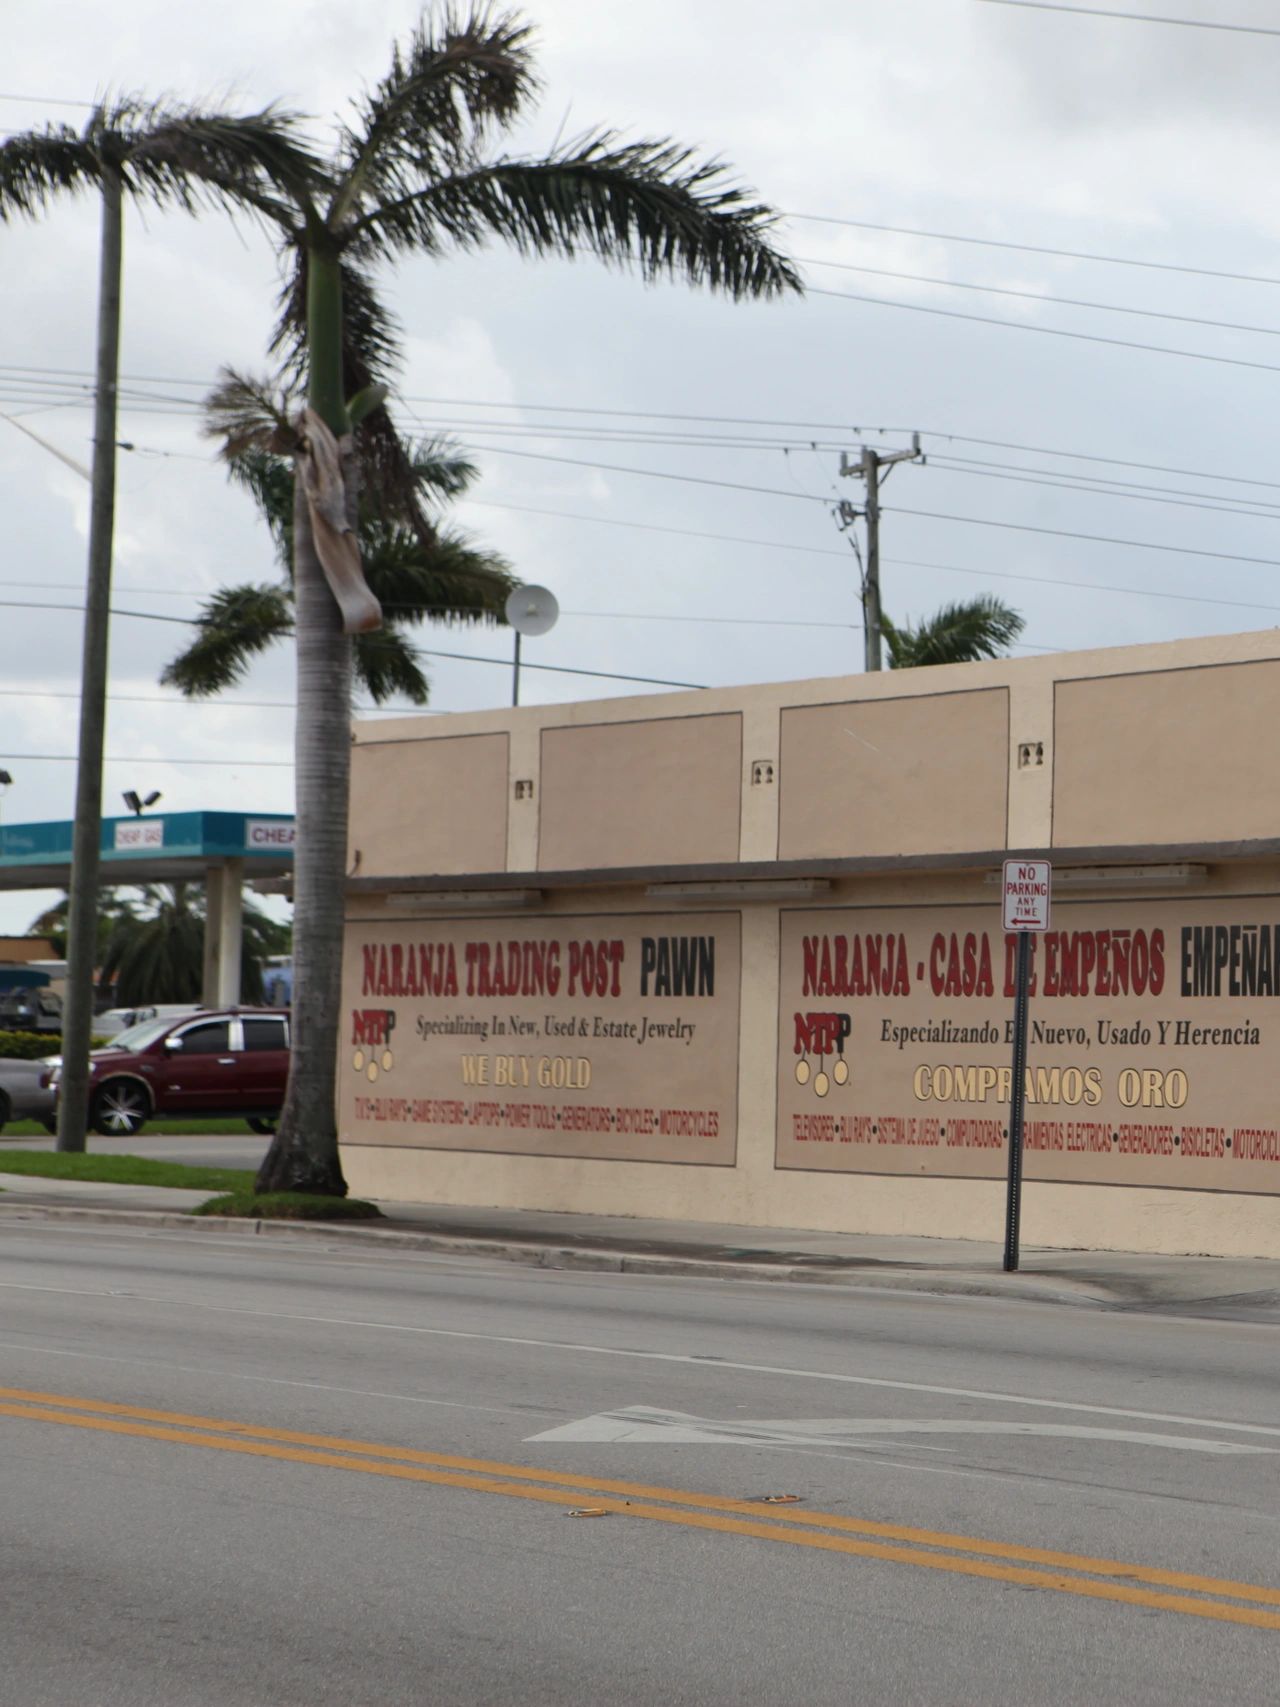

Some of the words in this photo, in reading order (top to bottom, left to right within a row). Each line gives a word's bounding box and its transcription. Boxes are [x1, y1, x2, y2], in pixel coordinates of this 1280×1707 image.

[252, 828, 296, 843] CHEA
[1006, 882, 1047, 896] PARKING
[1018, 867, 1036, 880] NO
[1015, 907, 1037, 917] TIME
[1017, 897, 1036, 906] ANY
[362, 943, 458, 997] NARANJA
[465, 940, 561, 997] TRADING
[568, 939, 625, 998] POST
[640, 936, 715, 997] PAWN
[802, 932, 911, 997] NARANJA
[930, 931, 994, 997] CASA
[1042, 928, 1166, 998] EMPEÑOS
[415, 1014, 489, 1043] Specializing
[491, 1015, 505, 1036] In
[508, 1015, 541, 1040] New,
[544, 1015, 576, 1037] Used
[578, 1017, 590, 1038] &
[593, 1016, 637, 1039] Estate
[637, 1016, 696, 1046] Jewelry
[880, 1018, 999, 1050] Especializando
[1004, 1019, 1015, 1044] E
[1032, 1020, 1091, 1049] Nuevo,
[1097, 1019, 1151, 1046] Usado
[1157, 1020, 1171, 1045] Y
[1173, 1019, 1261, 1046] Herencia
[460, 1053, 489, 1087] WE
[494, 1053, 534, 1088] BUY
[537, 1055, 593, 1090] GOLD
[913, 1064, 1102, 1106] COMPRAMOS
[1118, 1067, 1189, 1109] ORO
[562, 1105, 611, 1132] GENERATORS
[616, 1107, 654, 1134] BICYCLES
[660, 1109, 720, 1137] MOTORCYCLES
[947, 1119, 1003, 1148] COMPUTADORAS
[1066, 1122, 1112, 1152] ELECTRICAS
[1118, 1124, 1174, 1156] GENERADORES
